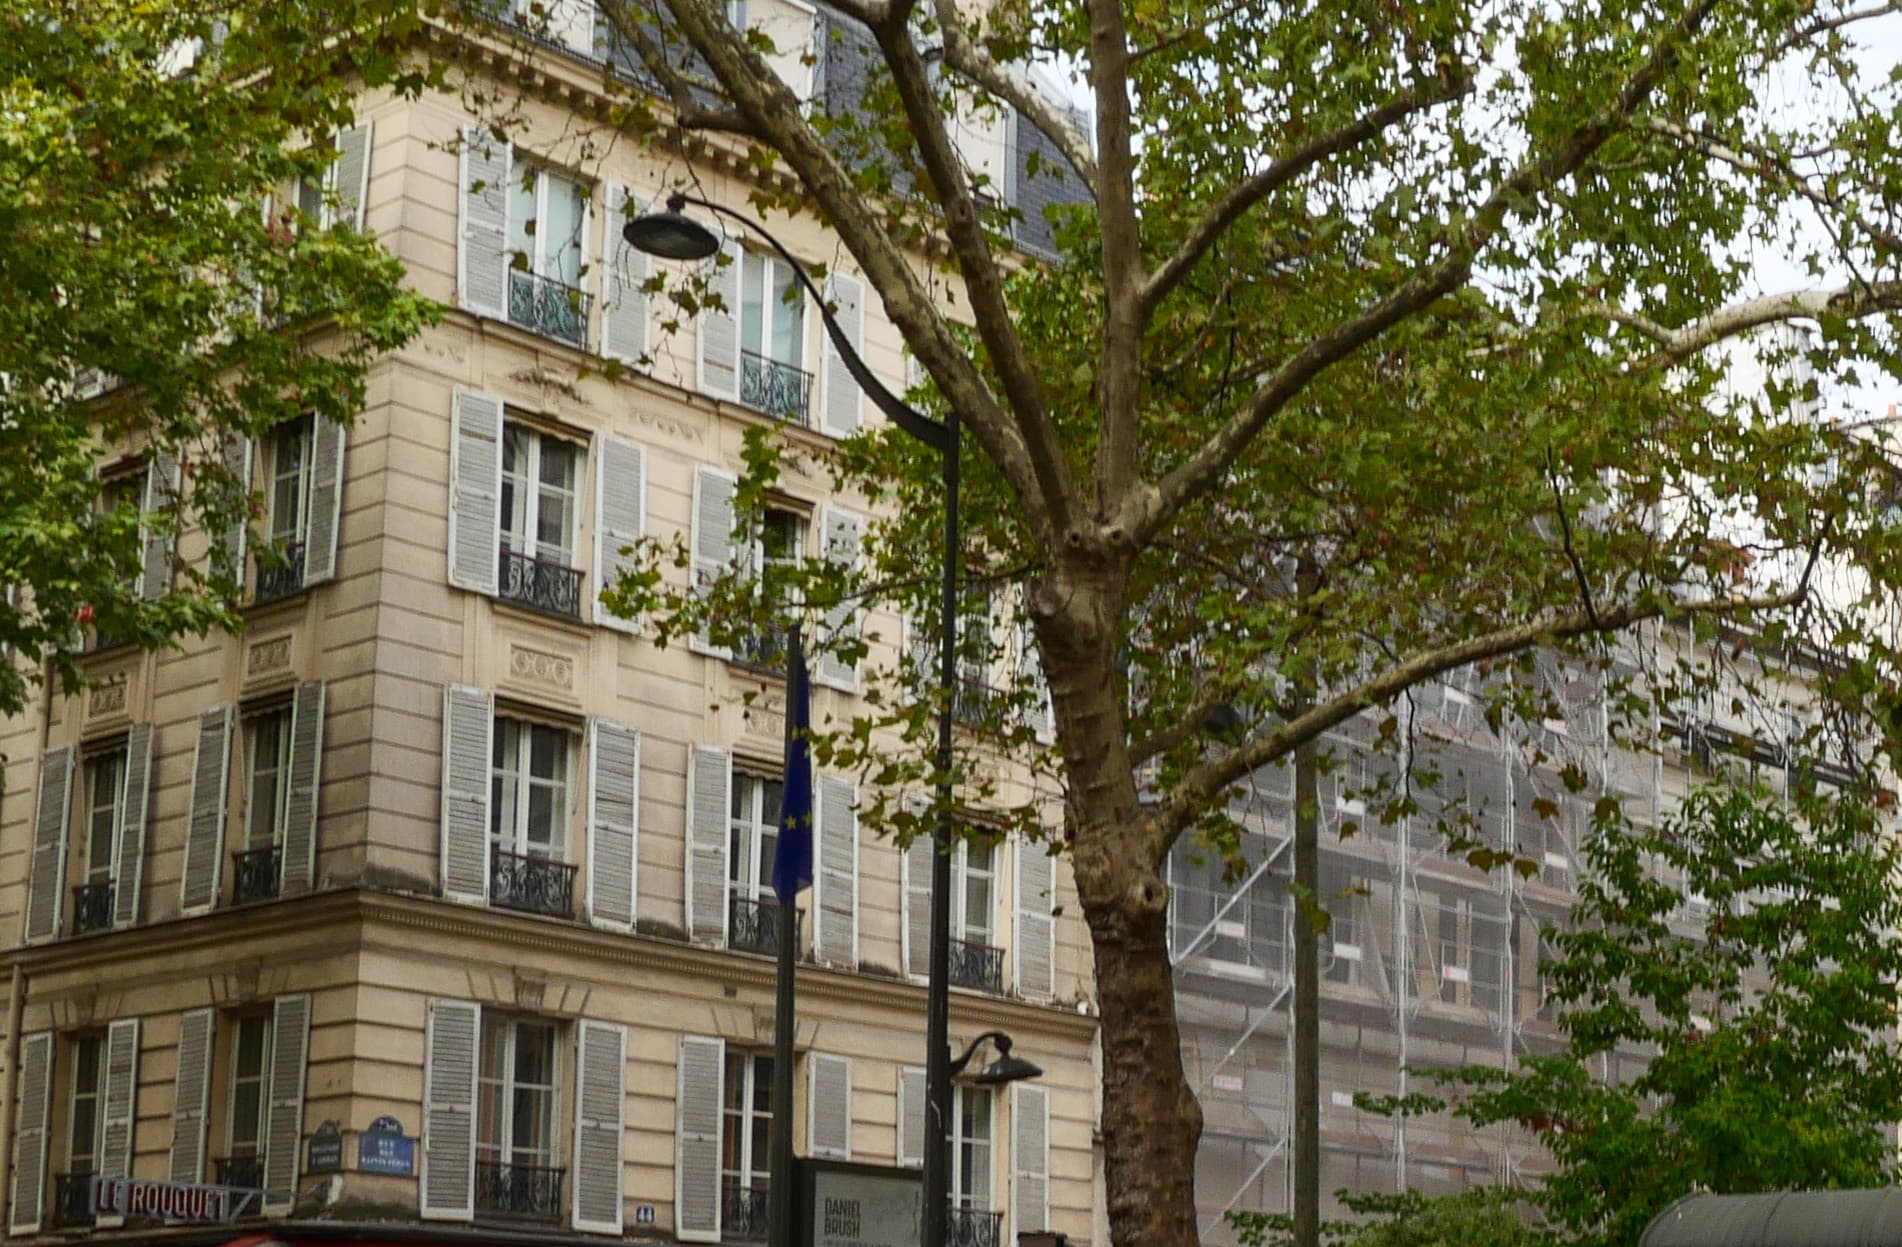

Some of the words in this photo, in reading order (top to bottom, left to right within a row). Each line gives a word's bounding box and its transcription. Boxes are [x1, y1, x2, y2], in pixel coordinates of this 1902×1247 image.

[130, 1183, 227, 1222] ROUQUET
[824, 1198, 861, 1218] DANIEL
[824, 1218, 861, 1239] BRUSH
